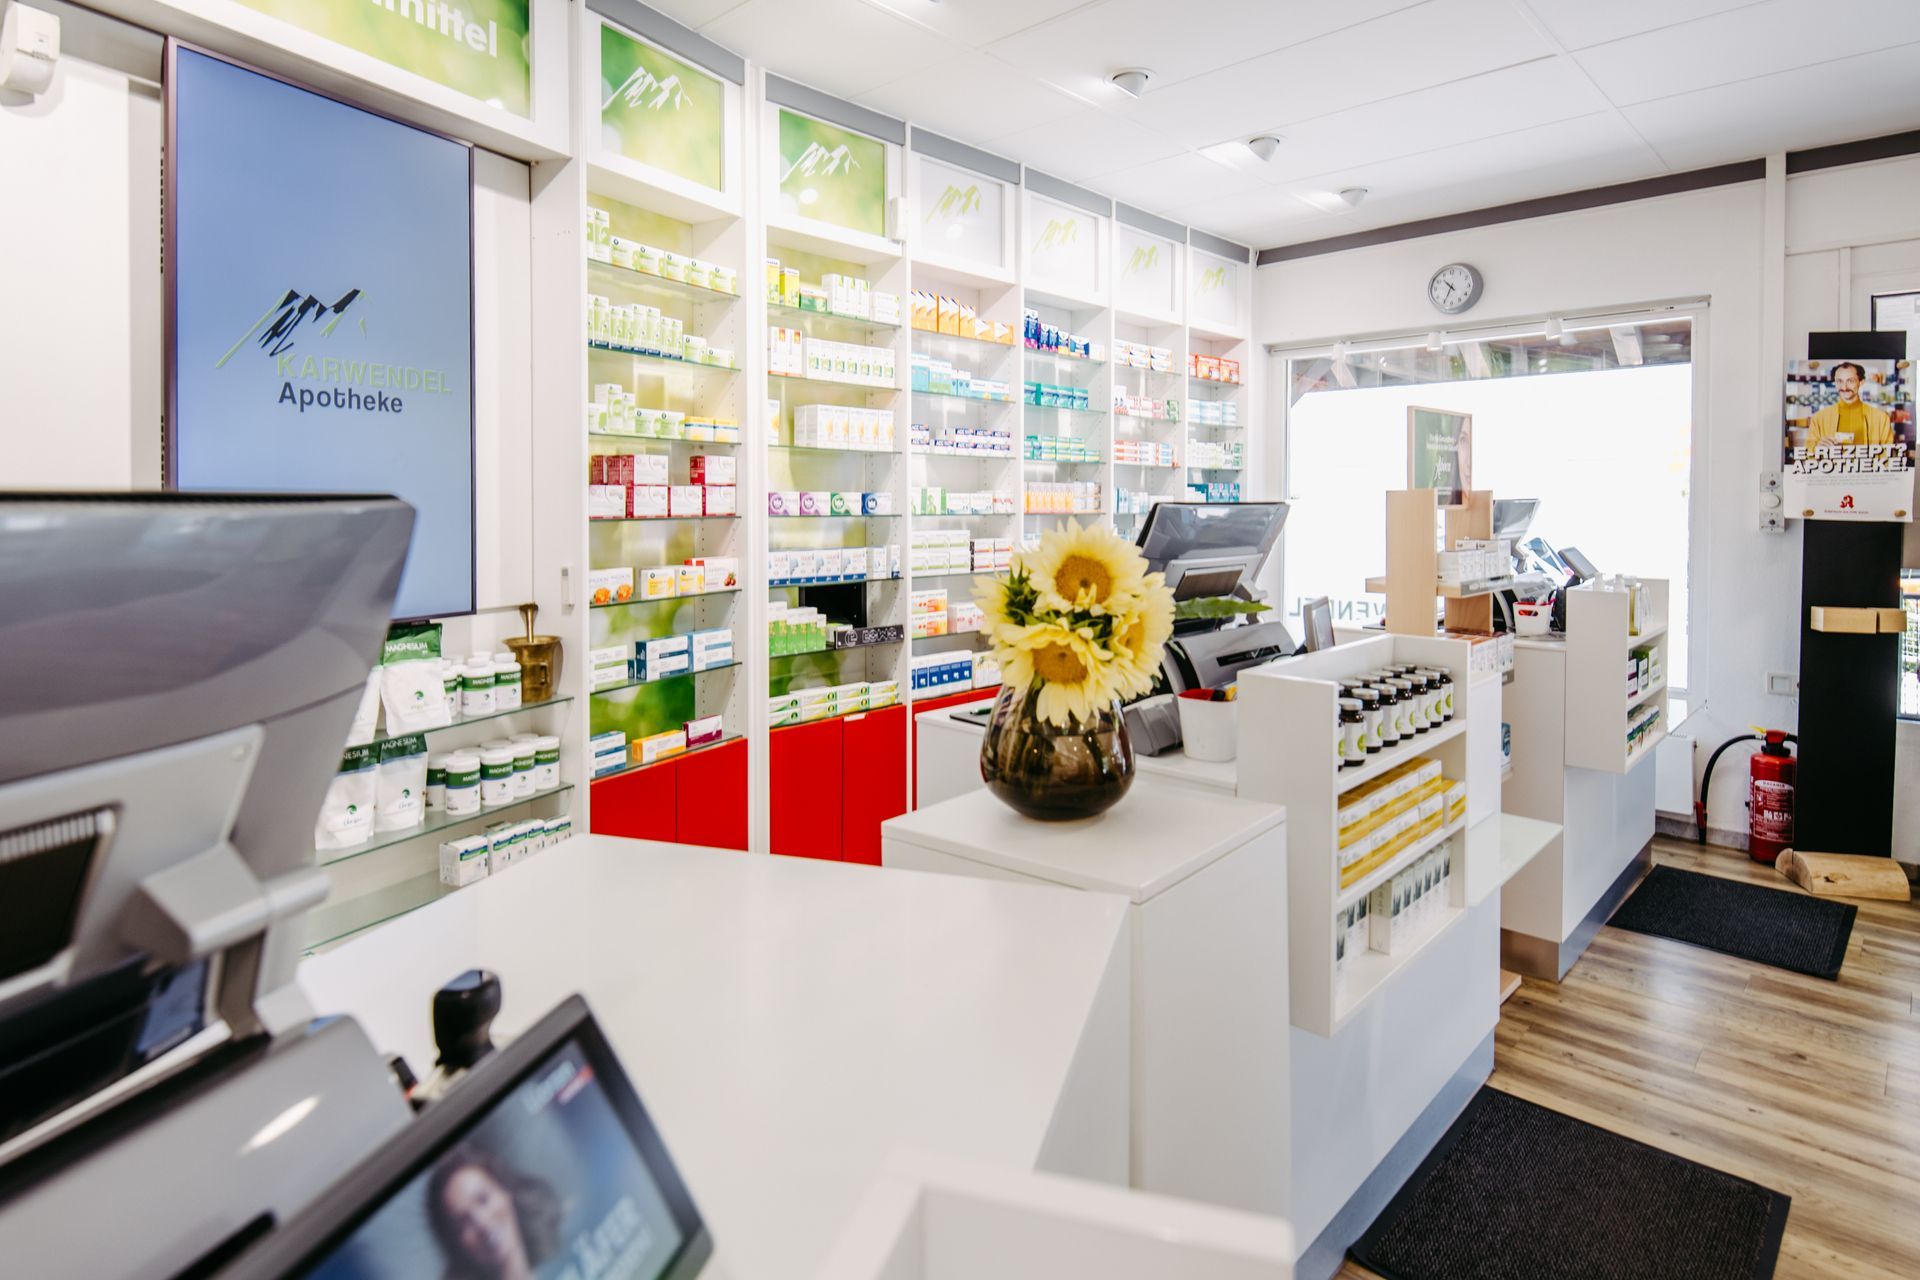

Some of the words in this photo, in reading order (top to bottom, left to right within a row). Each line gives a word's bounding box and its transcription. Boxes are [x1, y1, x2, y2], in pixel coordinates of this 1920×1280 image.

[277, 352, 454, 395] KARWENDEL
[278, 382, 403, 414] Apotheke
[1793, 443, 1908, 461] E-REZEPT?
[1792, 457, 1909, 475] APOTHEKE!
[385, 641, 428, 653] MAGNESIUM
